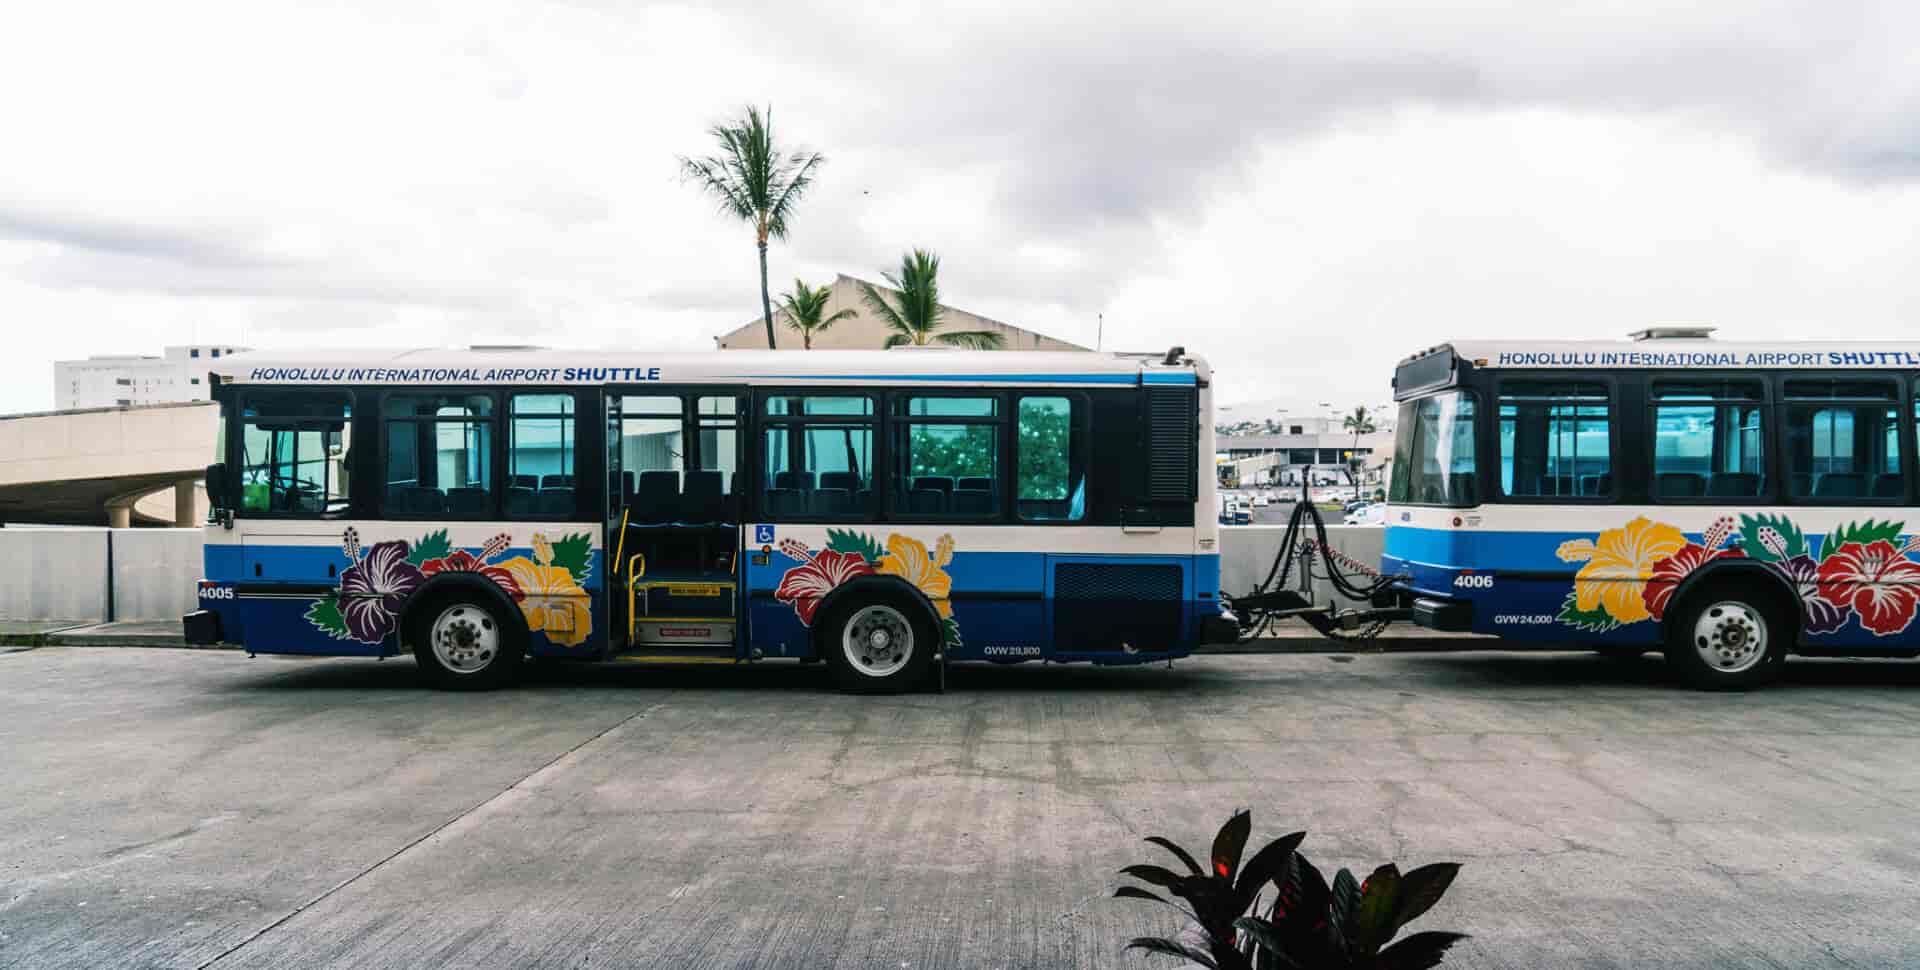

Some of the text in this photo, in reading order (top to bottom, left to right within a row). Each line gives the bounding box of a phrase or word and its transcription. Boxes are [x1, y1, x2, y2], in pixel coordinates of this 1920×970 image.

[1499, 352, 1920, 366] HONOLULU INTERNATIONAL AIRPORT SHUTTL
[250, 367, 661, 382] HONOLULU INTERNATIONAL AIRPORT SHUTTLE
[1453, 575, 1494, 588] 4006
[199, 587, 234, 600] 4005
